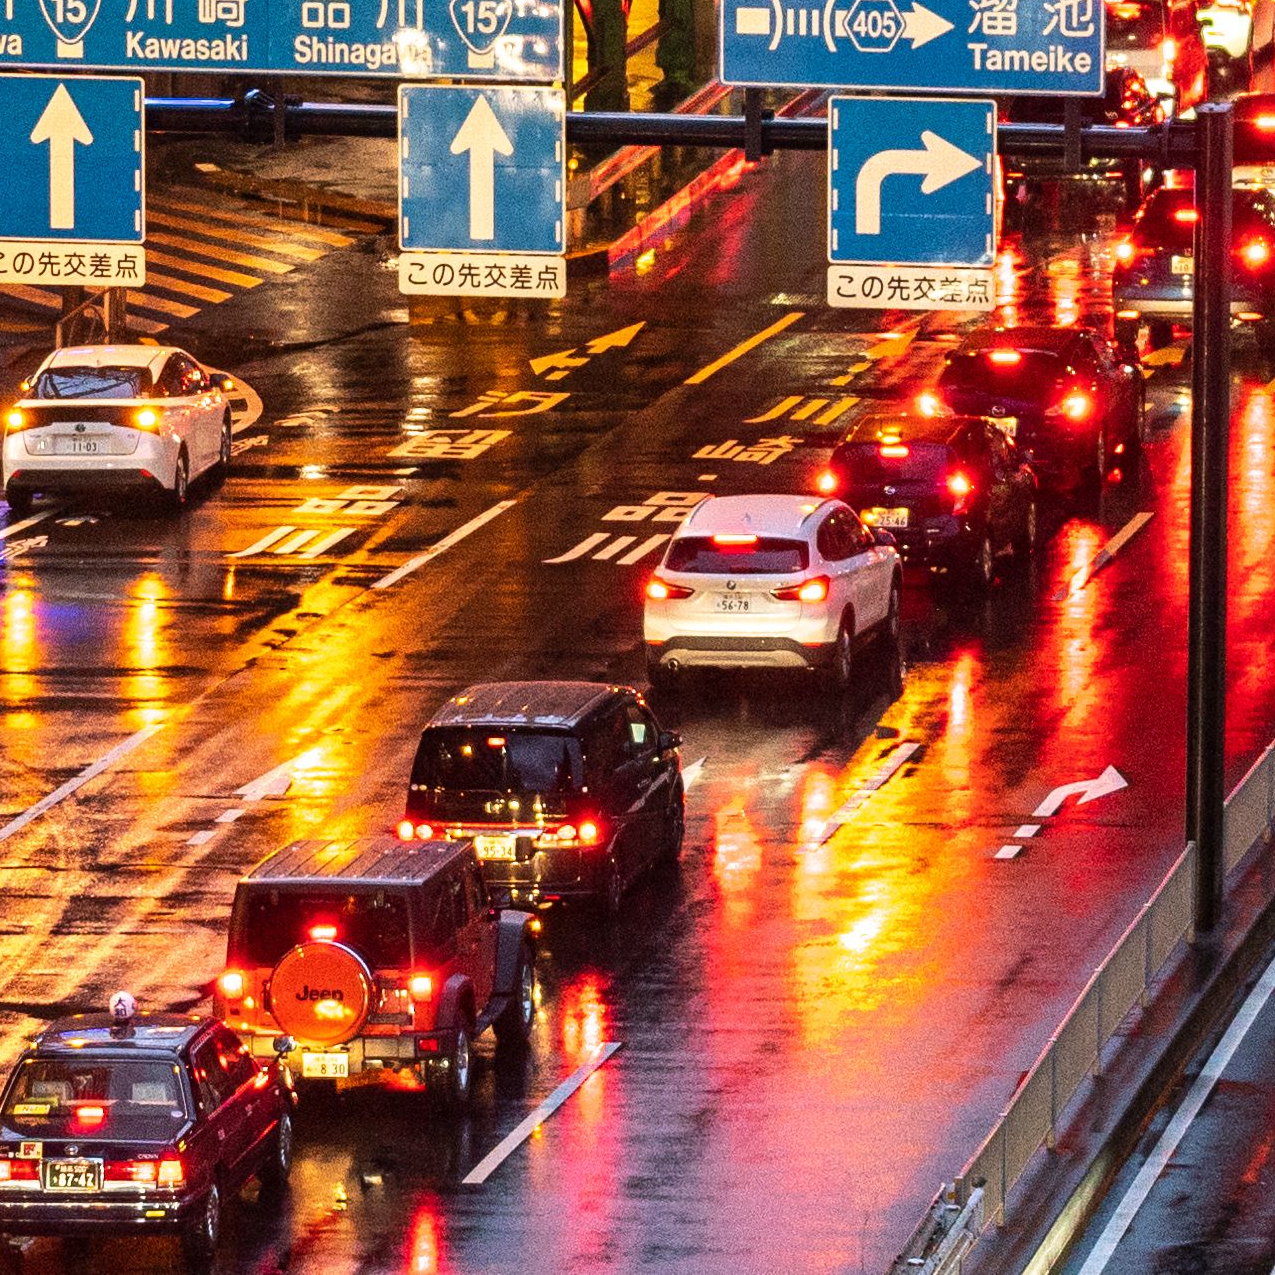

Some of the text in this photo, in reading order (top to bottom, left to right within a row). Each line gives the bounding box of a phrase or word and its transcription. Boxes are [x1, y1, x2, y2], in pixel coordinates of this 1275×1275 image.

[461, 1, 498, 34] 15
[853, 9, 897, 30] 405
[126, 32, 248, 63] Kawasaki
[293, 35, 433, 68] Shinagawa
[968, 42, 1093, 74] Tameike
[407, 258, 562, 294] この先交差点
[836, 273, 991, 308] この先交差点
[72, 442, 97, 452] 11-03
[721, 600, 749, 611] 56-78
